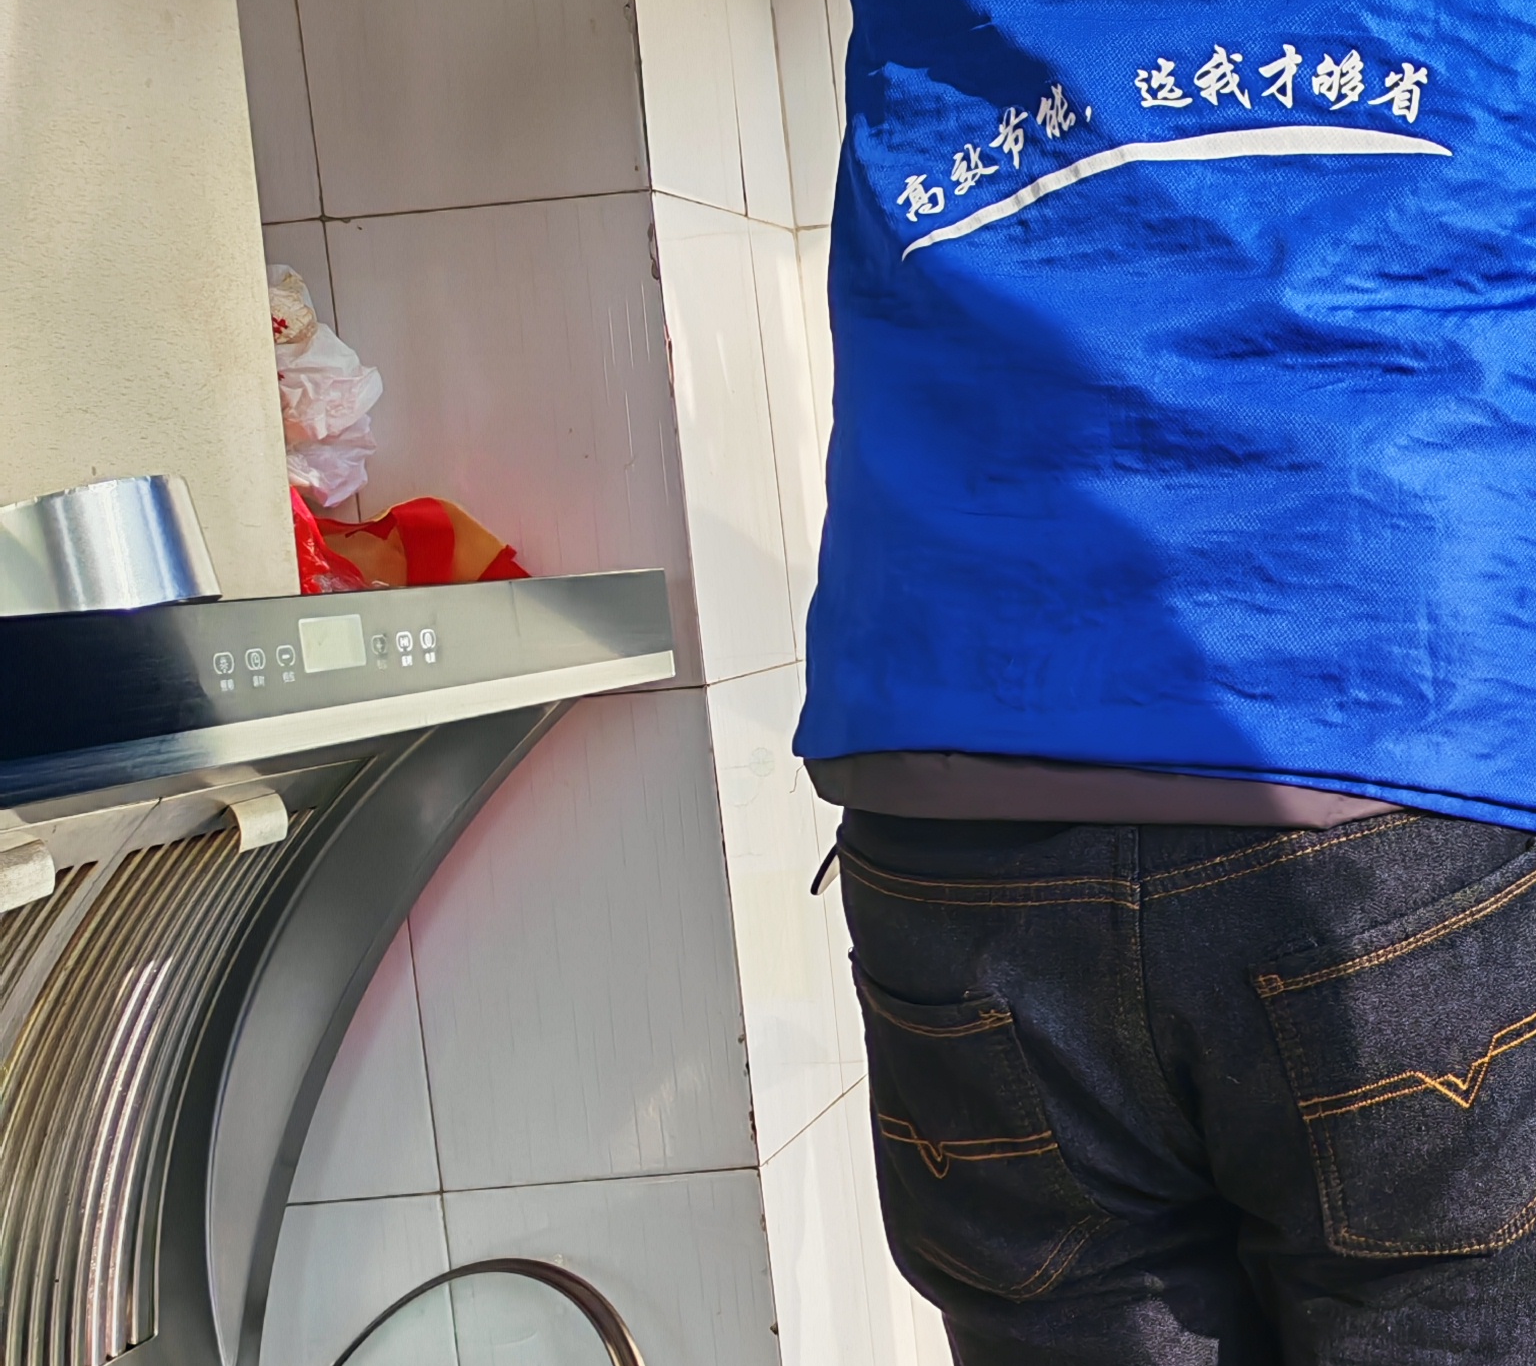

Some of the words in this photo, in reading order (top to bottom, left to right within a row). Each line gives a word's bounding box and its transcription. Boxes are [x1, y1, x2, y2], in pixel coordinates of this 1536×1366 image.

[1134, 45, 1430, 124] 选我才够省
